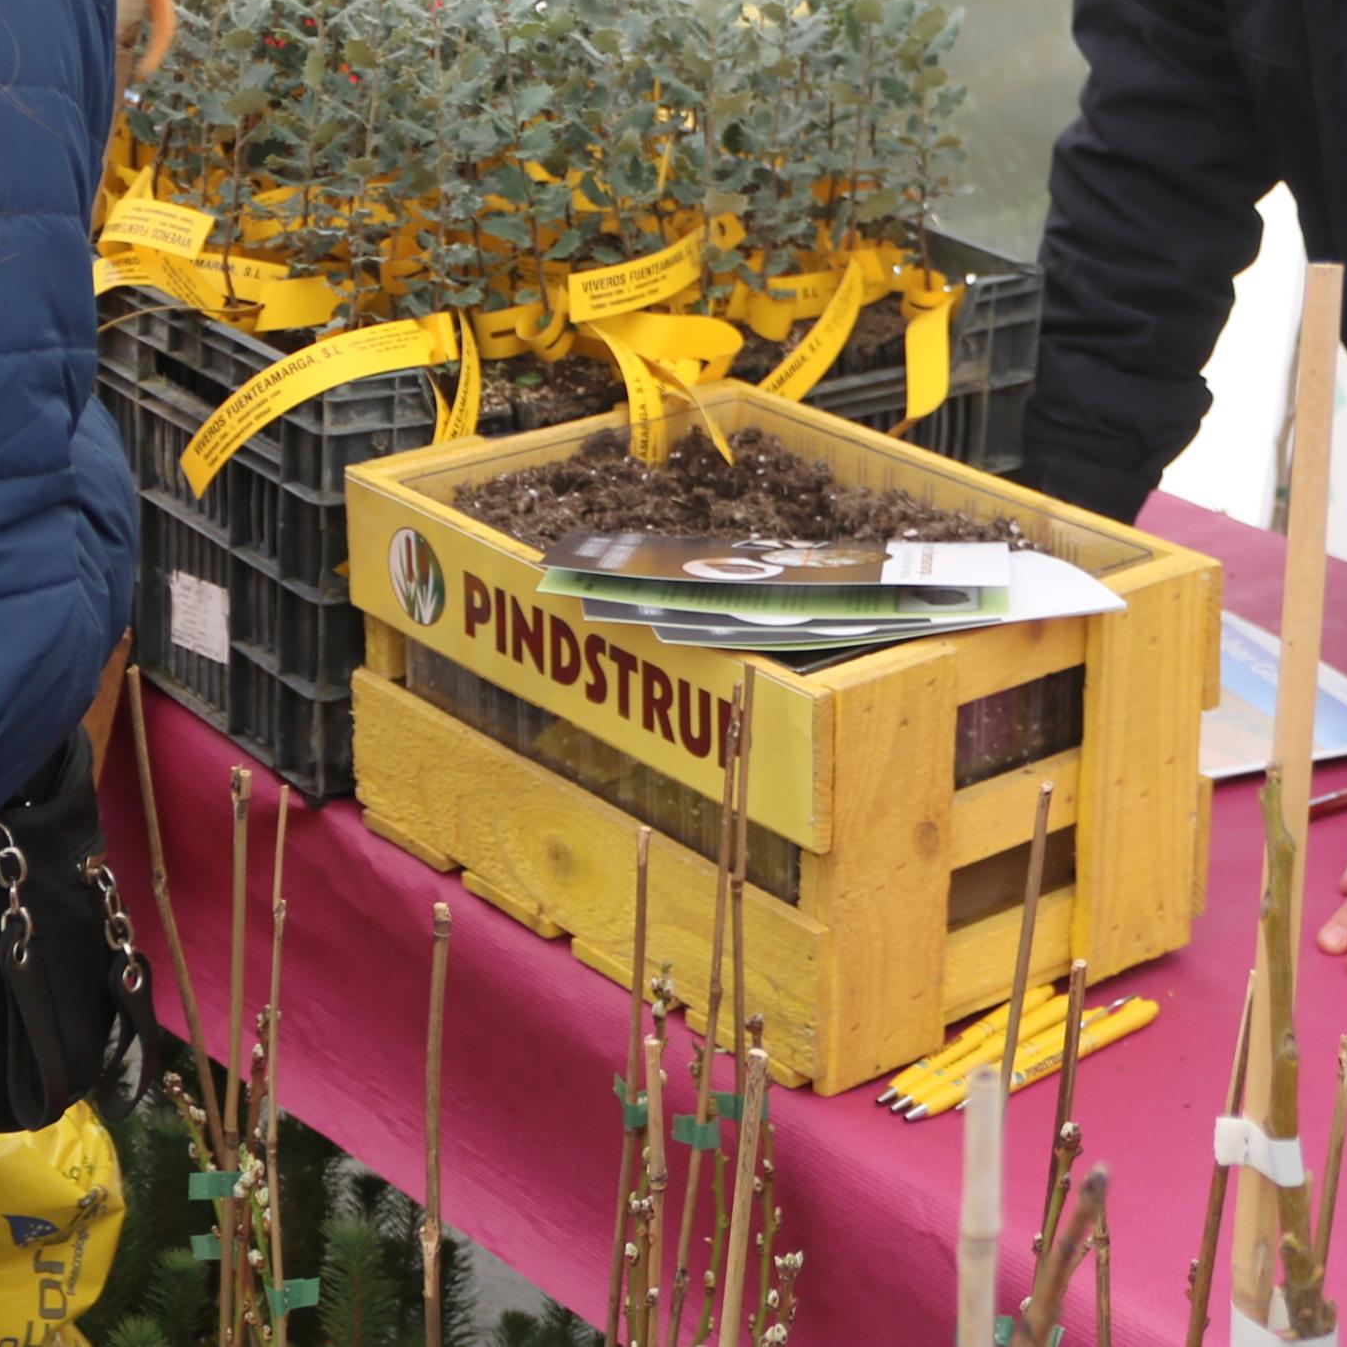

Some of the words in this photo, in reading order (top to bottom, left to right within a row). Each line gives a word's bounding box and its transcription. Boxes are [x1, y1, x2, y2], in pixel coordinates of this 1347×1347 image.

[581, 273, 626, 294] VIVEROS
[194, 415, 227, 456] VIVEROS
[225, 354, 321, 421] FUENTEAMARGA,
